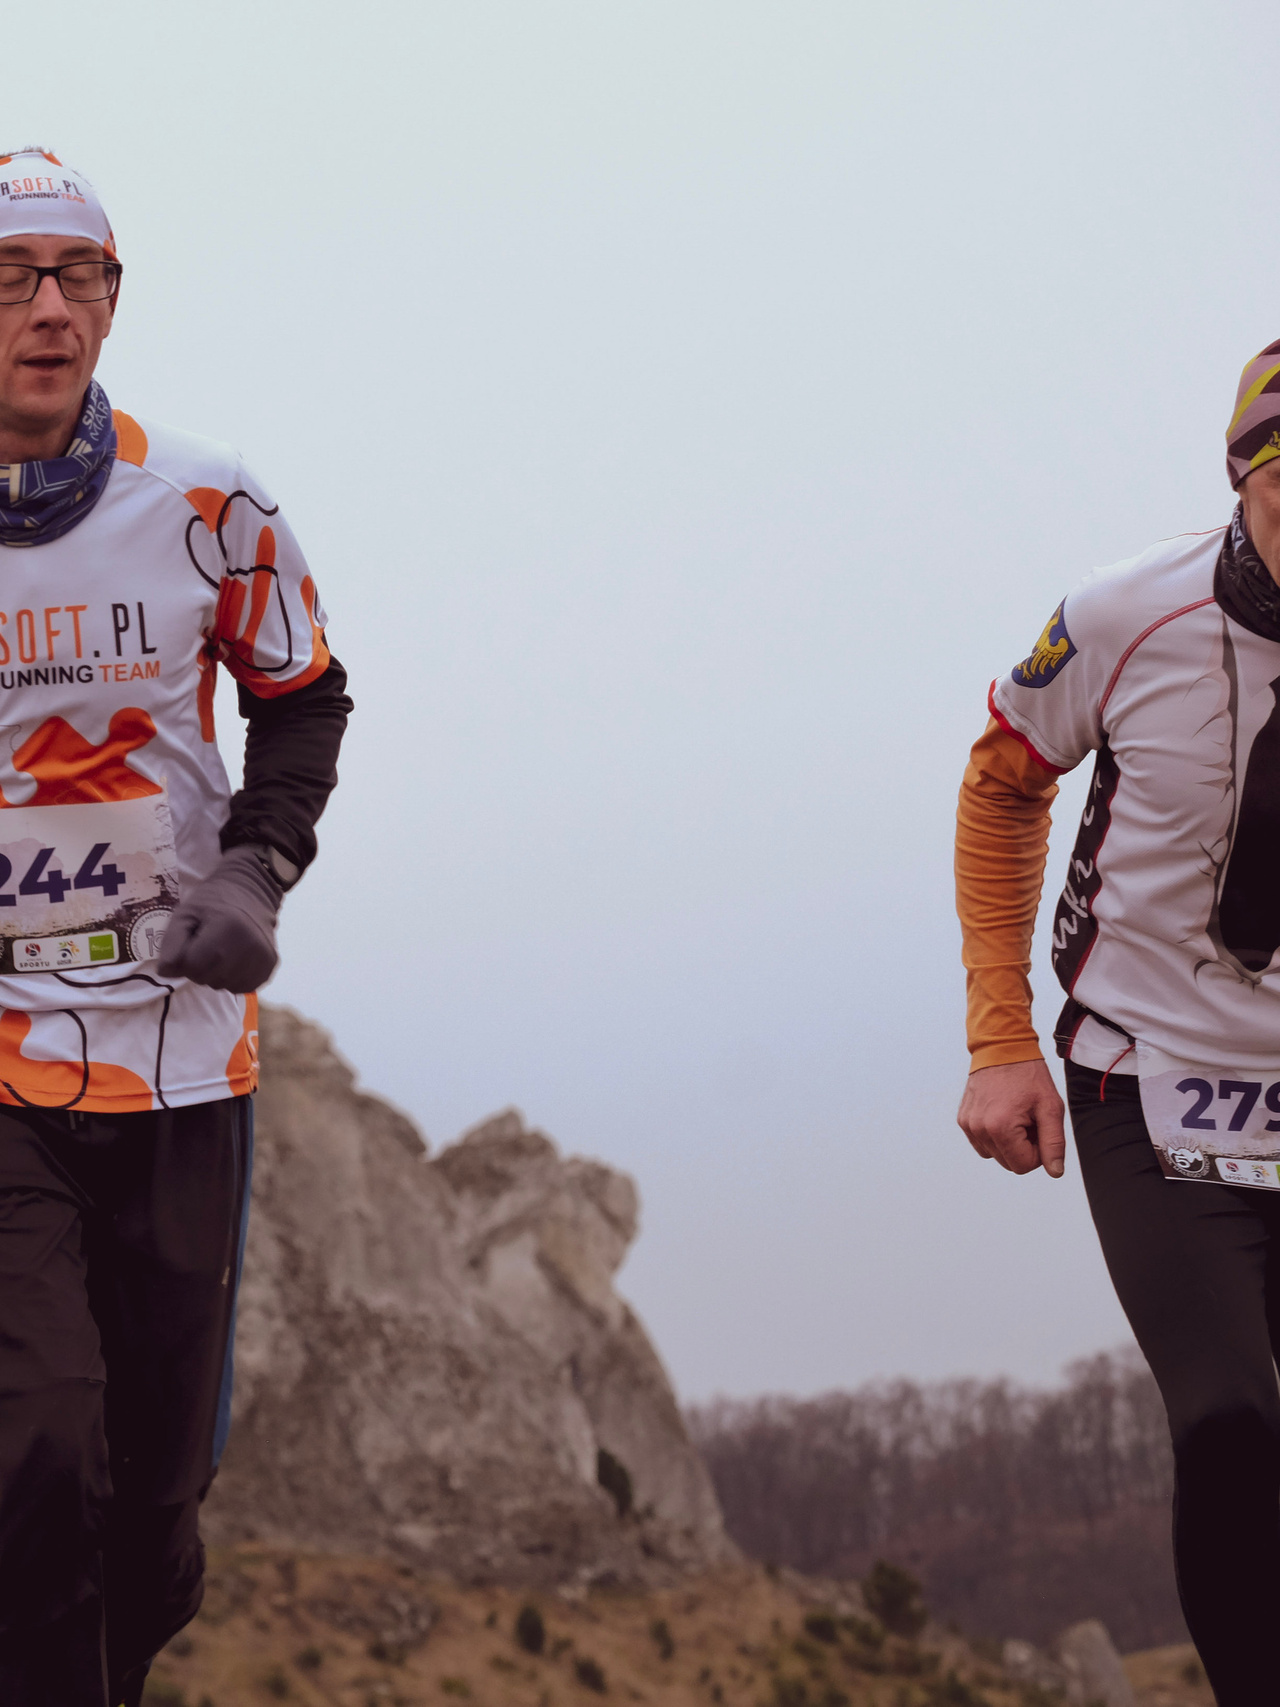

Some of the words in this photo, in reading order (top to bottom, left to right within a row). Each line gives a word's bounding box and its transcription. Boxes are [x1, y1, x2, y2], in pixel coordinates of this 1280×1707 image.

[9, 191, 59, 202] RUNNING
[61, 192, 87, 204] TEAM
[98, 660, 161, 683] TEAM
[1174, 1155, 1191, 1169] 5
